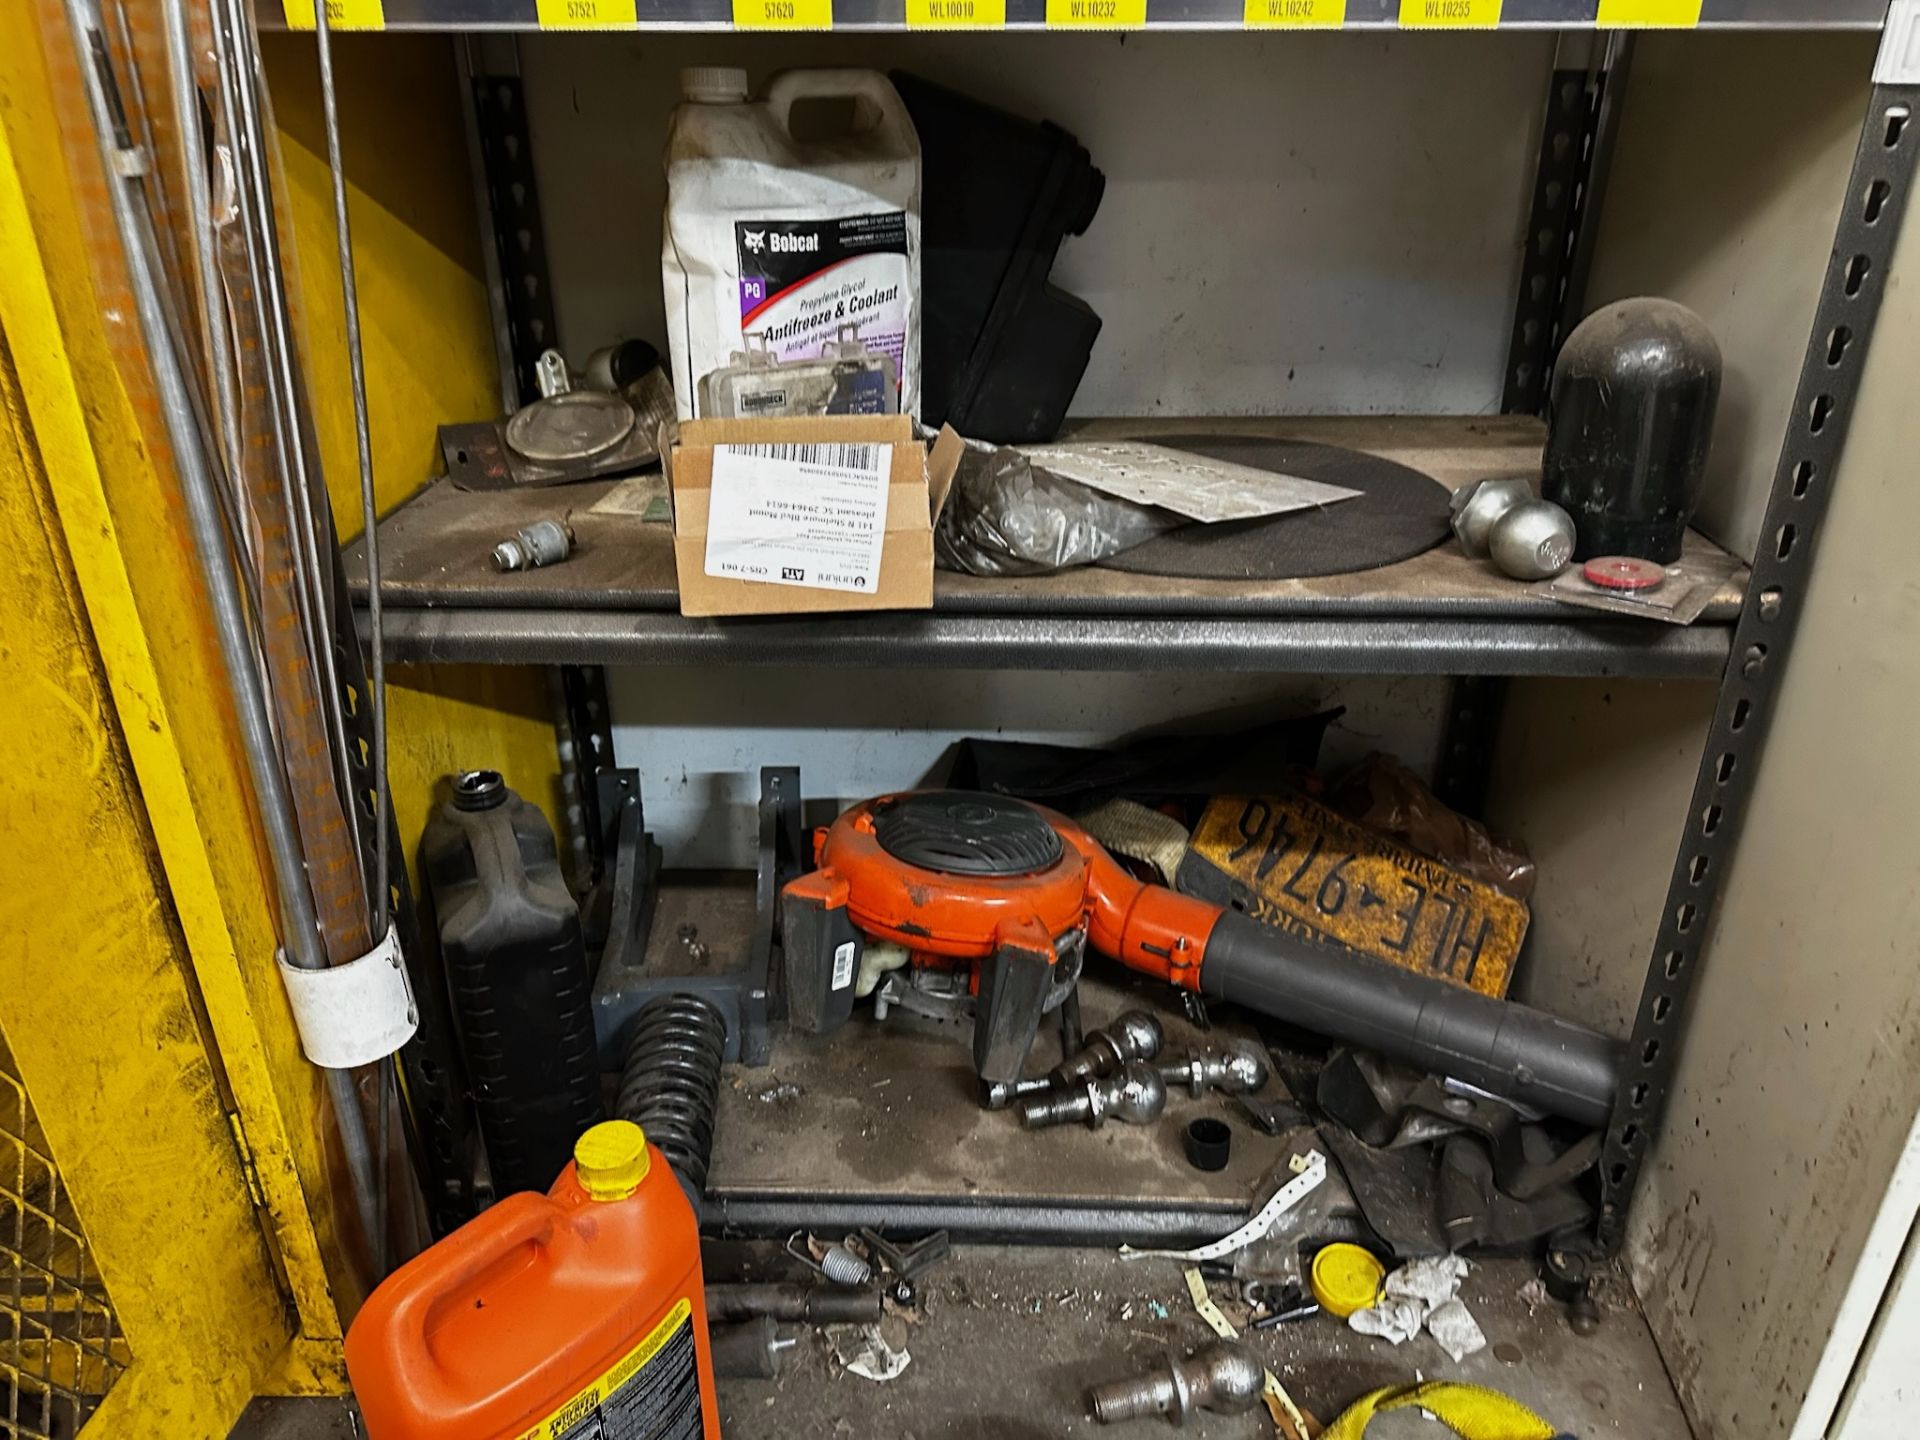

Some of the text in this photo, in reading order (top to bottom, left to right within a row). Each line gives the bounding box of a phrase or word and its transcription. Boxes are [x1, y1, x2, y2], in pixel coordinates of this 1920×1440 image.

[567, 2, 597, 19] 57521
[764, 2, 794, 20] 57620
[929, 1, 974, 18] WL10010
[1070, 1, 1116, 18] WL10232
[1268, 0, 1314, 17] WL10242
[1425, 0, 1471, 18] WL10255
[769, 232, 819, 253] Bobcat
[744, 282, 761, 299] PG
[799, 277, 866, 312] Propylene Glycol
[764, 284, 898, 342] Antifreeze & Coolant
[785, 336, 810, 353] Antigel
[748, 507, 872, 530] 141 N Shelmore Blvd Mount
[821, 505, 833, 515] SC
[836, 507, 875, 519] pleasant
[782, 566, 804, 580] ATL
[1229, 800, 1490, 984] HLE 9746
